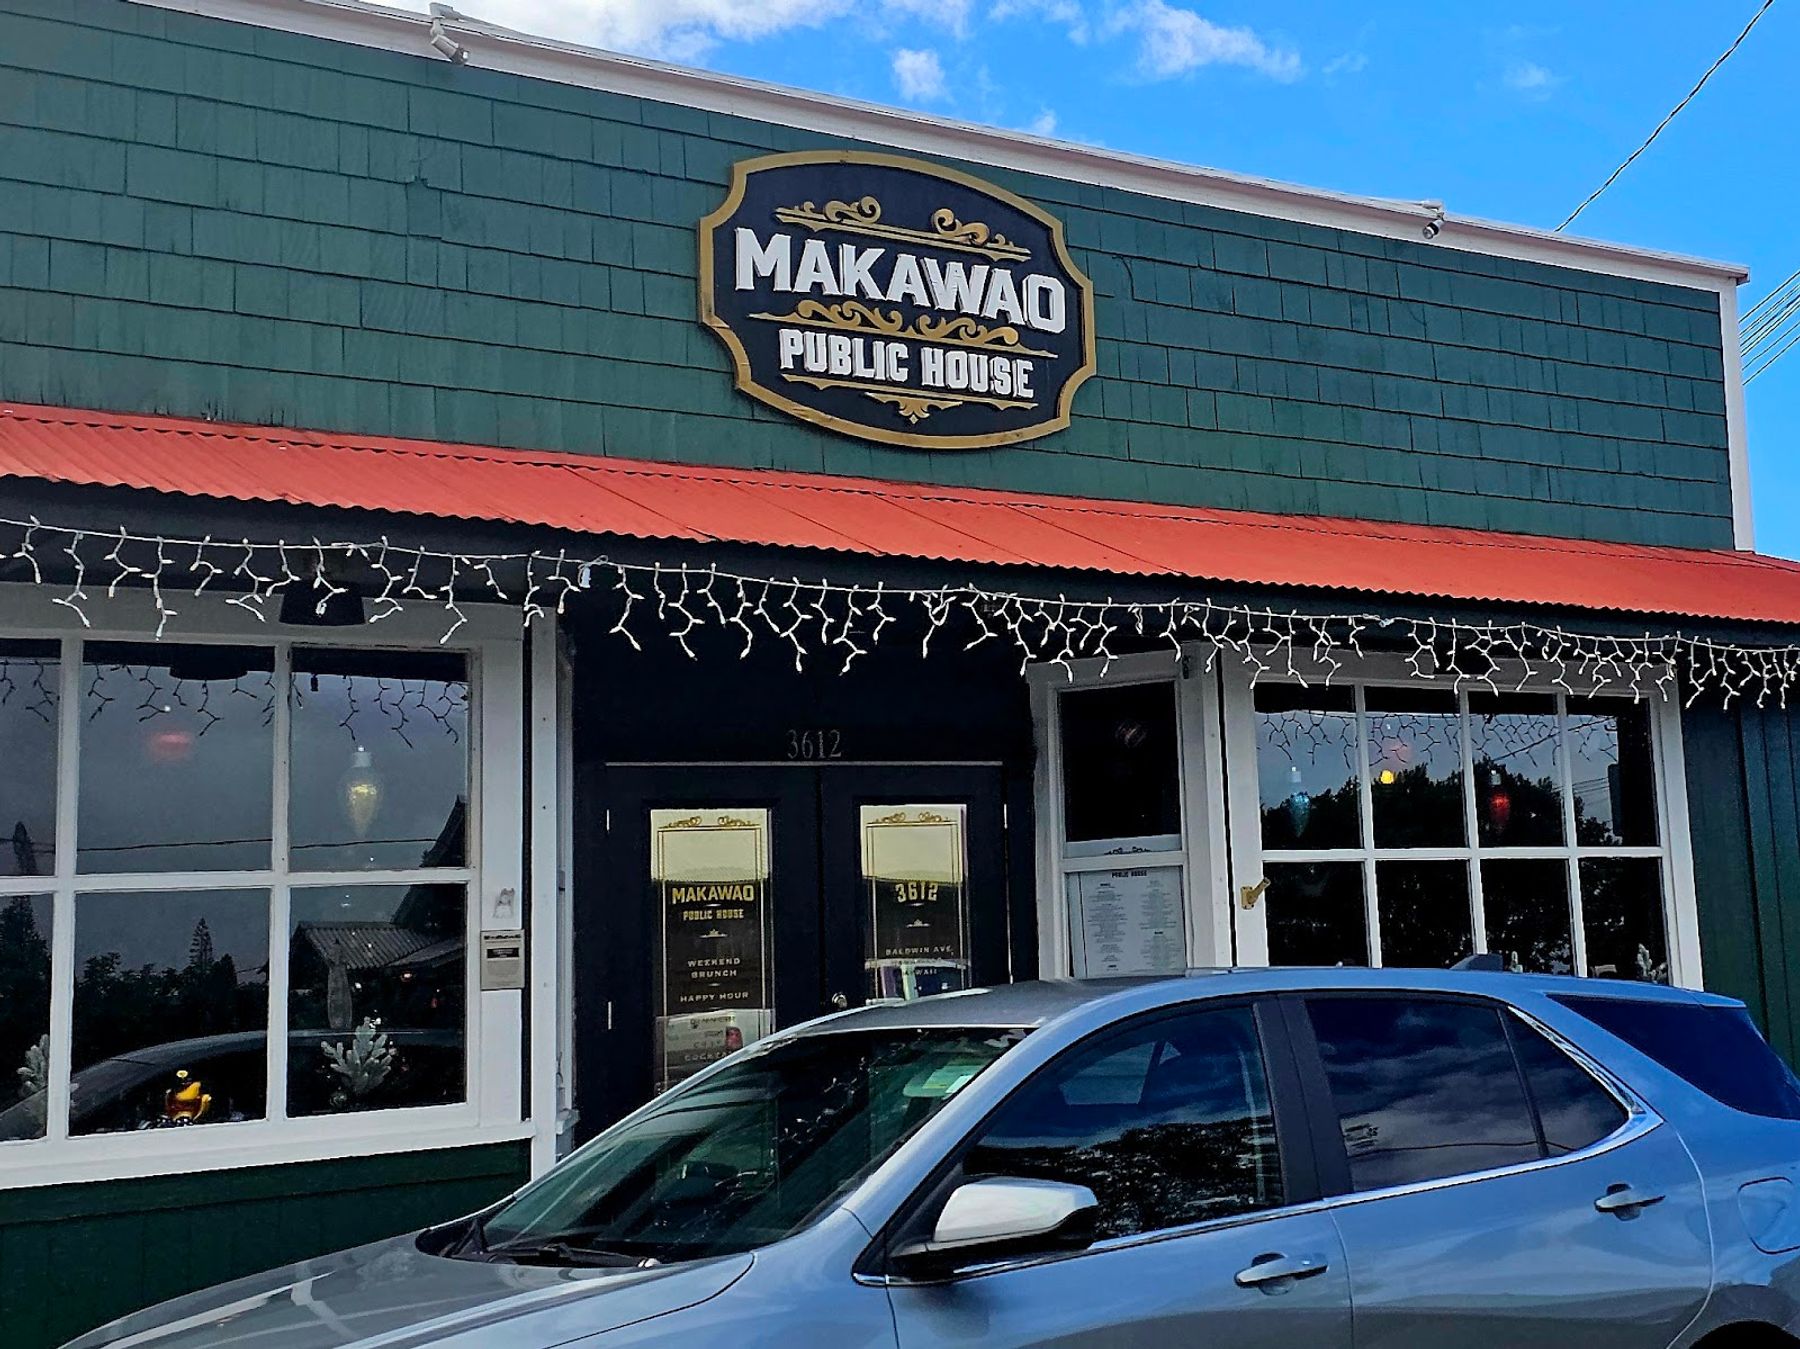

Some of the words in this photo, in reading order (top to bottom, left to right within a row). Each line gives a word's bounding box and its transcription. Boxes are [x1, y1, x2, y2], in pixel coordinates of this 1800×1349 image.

[734, 227, 1066, 334] MAKAWAO
[778, 328, 909, 382] PUBLIC
[920, 347, 1035, 399] HOUSE
[786, 729, 842, 759] 3612
[671, 885, 755, 904] MAKAWAO
[895, 881, 939, 903] 3612
[683, 910, 714, 921] PUBLIC
[716, 909, 745, 920] HOUSE
[885, 947, 930, 956] BALDWIN
[687, 958, 741, 968] WEEKEND
[691, 970, 737, 979] BRUNCH
[680, 994, 716, 1003] HAPPY
[719, 992, 749, 1000] HOUR
